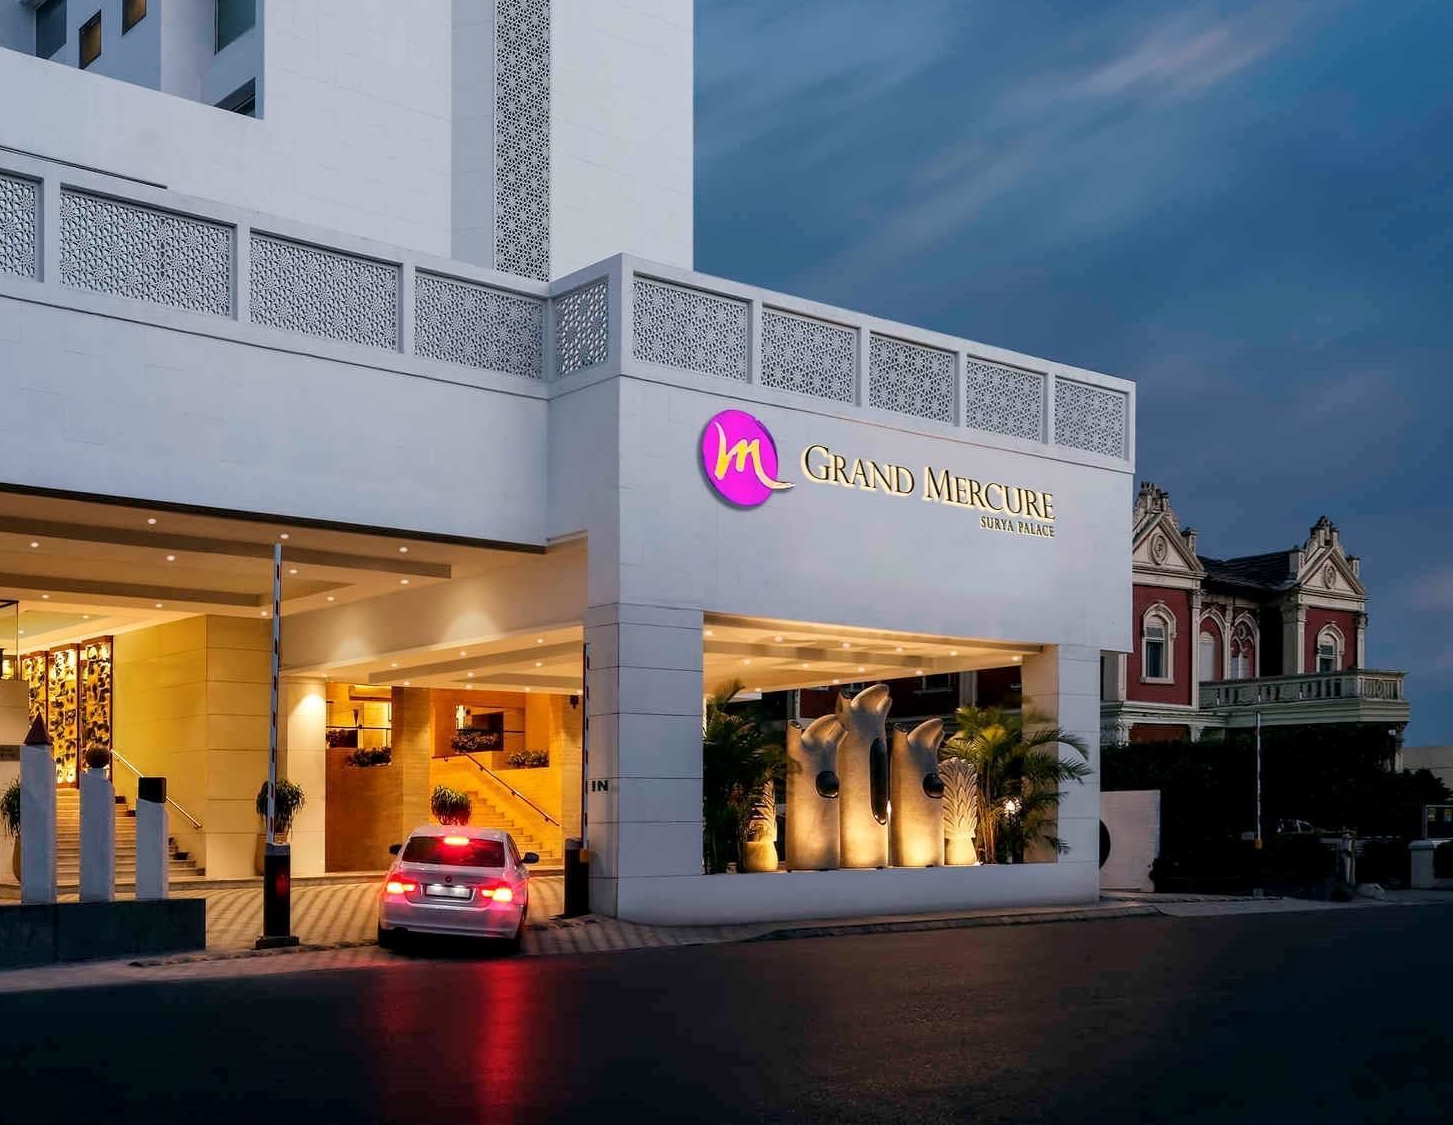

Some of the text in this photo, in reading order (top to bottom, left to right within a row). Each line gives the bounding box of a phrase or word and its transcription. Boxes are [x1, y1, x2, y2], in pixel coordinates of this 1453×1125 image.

[802, 443, 1057, 522] GRAND MERCURE
[980, 515, 1056, 537] SURYA PALACE
[591, 780, 609, 792] IN
